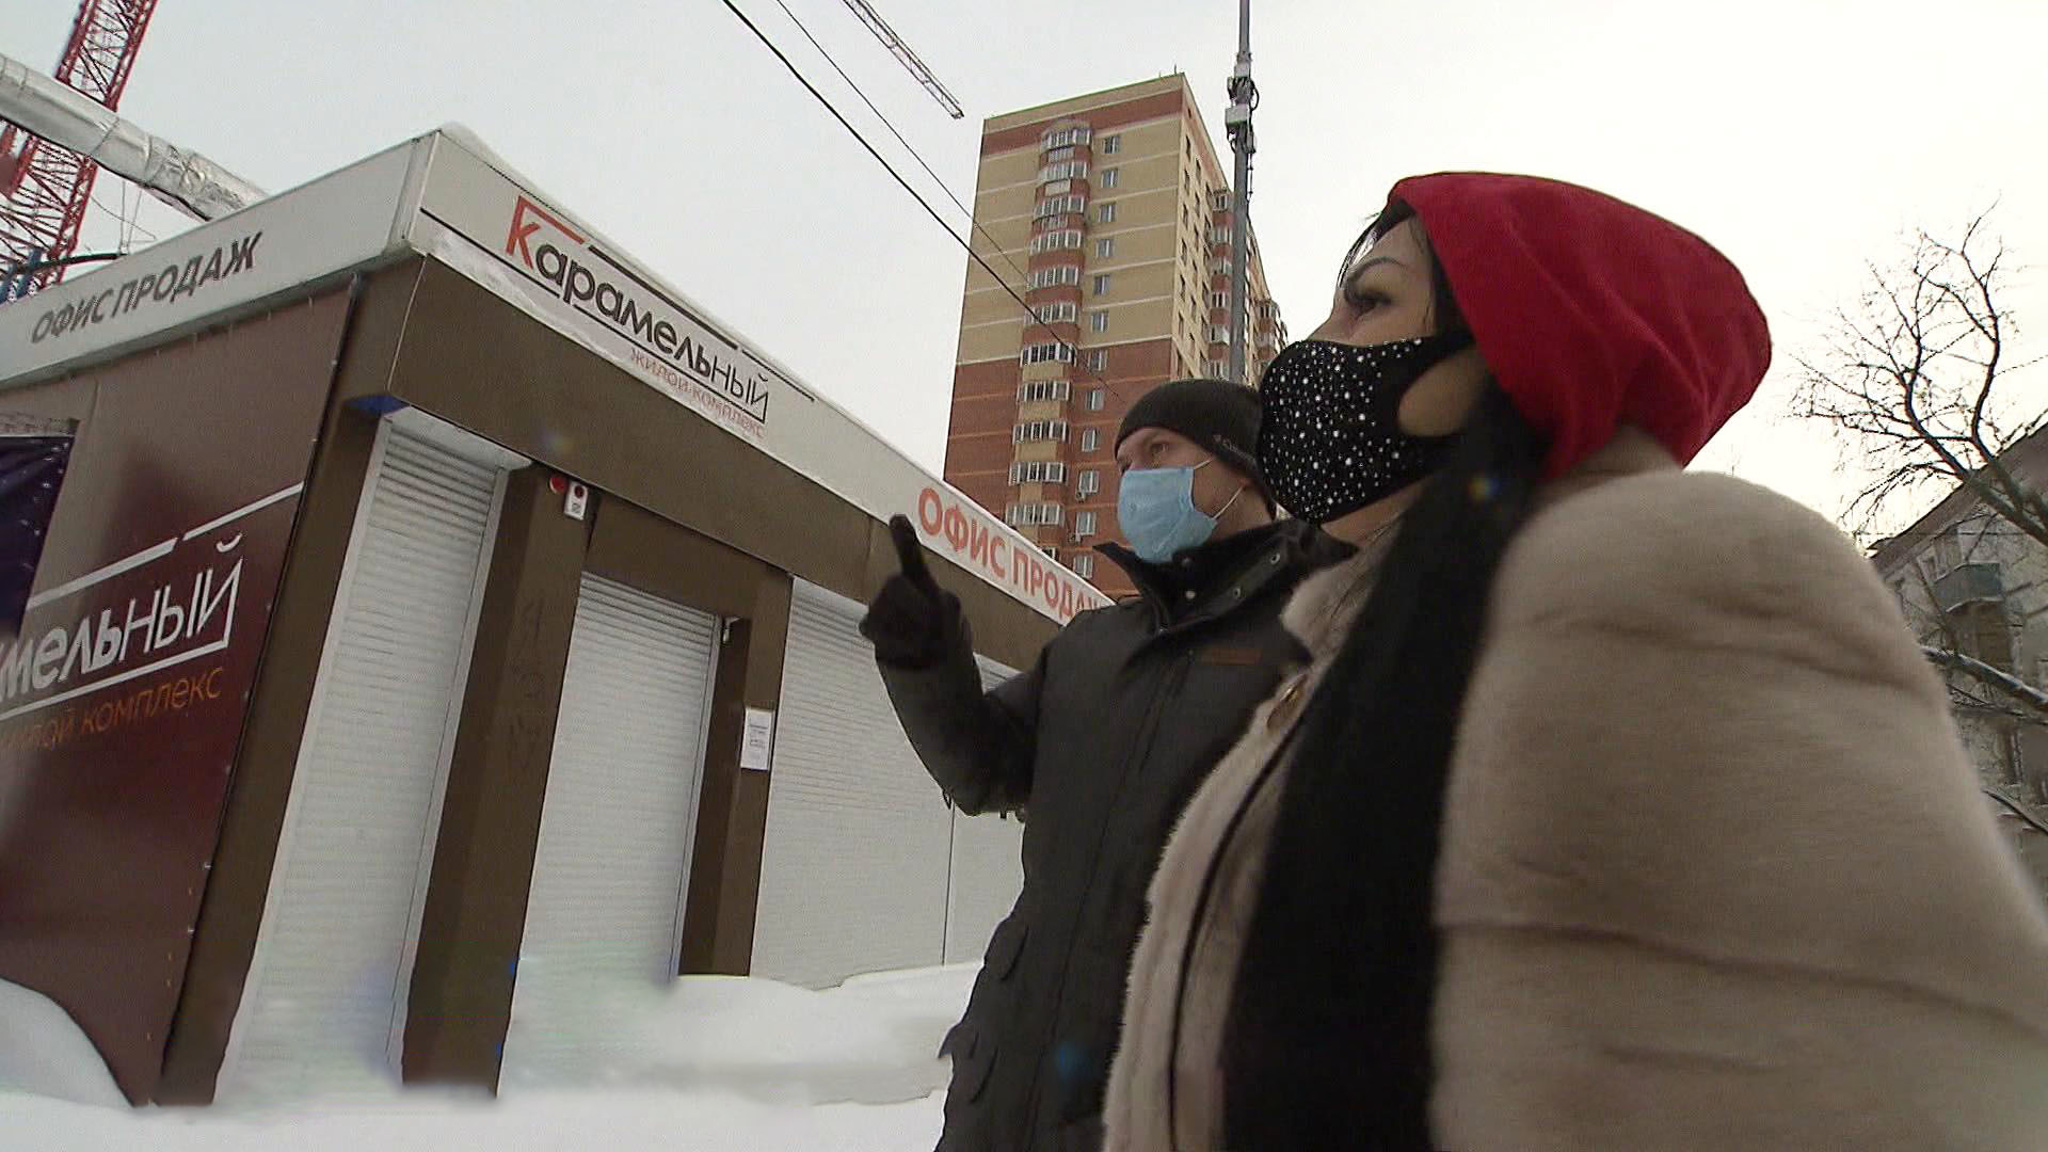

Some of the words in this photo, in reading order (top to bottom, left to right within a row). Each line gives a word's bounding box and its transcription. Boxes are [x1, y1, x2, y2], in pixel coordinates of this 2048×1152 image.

[32, 288, 113, 343] ОФИС
[111, 231, 262, 318] ПРОДАЖ
[505, 195, 769, 423] Карамельный
[918, 487, 1006, 579] ОФИС
